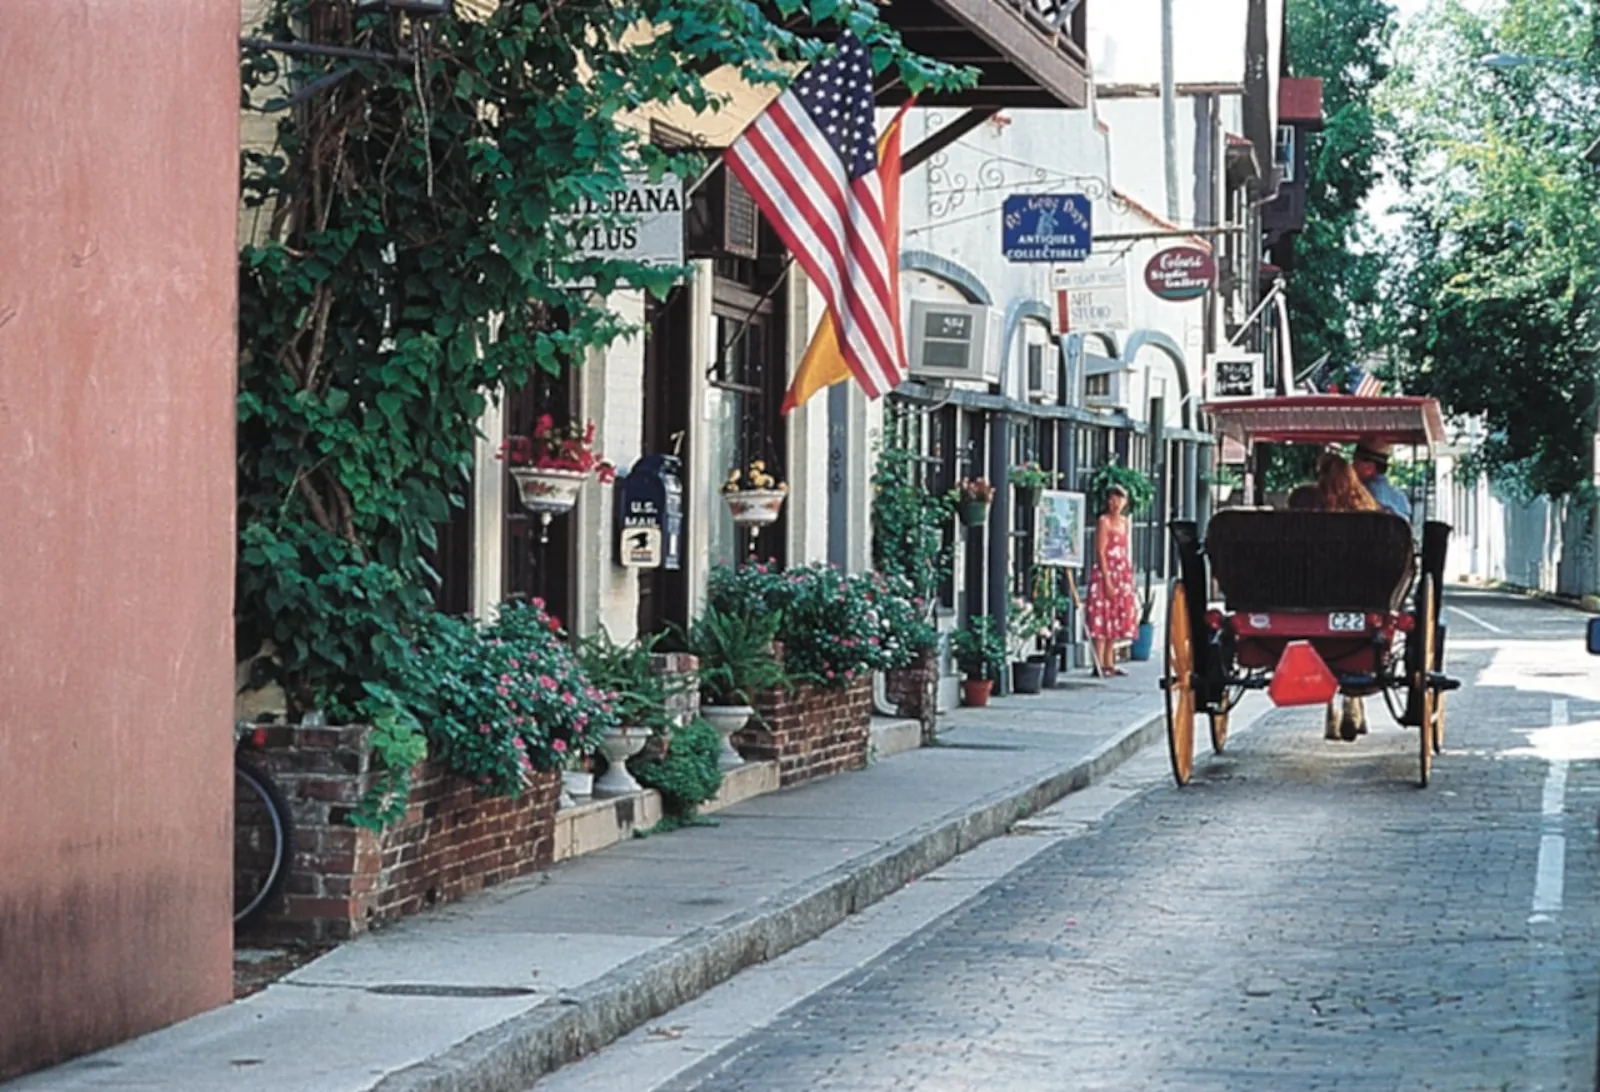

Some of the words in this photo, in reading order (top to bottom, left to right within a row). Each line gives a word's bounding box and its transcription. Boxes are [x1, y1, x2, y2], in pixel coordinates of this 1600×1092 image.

[1018, 234, 1076, 246] ANTIQUES
[1007, 249, 1087, 259] COLLECTIBLES
[1151, 270, 1187, 280] Studio
[1165, 278, 1209, 289] Gallery
[1072, 292, 1093, 306] ART
[1072, 306, 1112, 319] STUDIO
[631, 501, 658, 513] U.S.
[1331, 612, 1363, 629] C22
